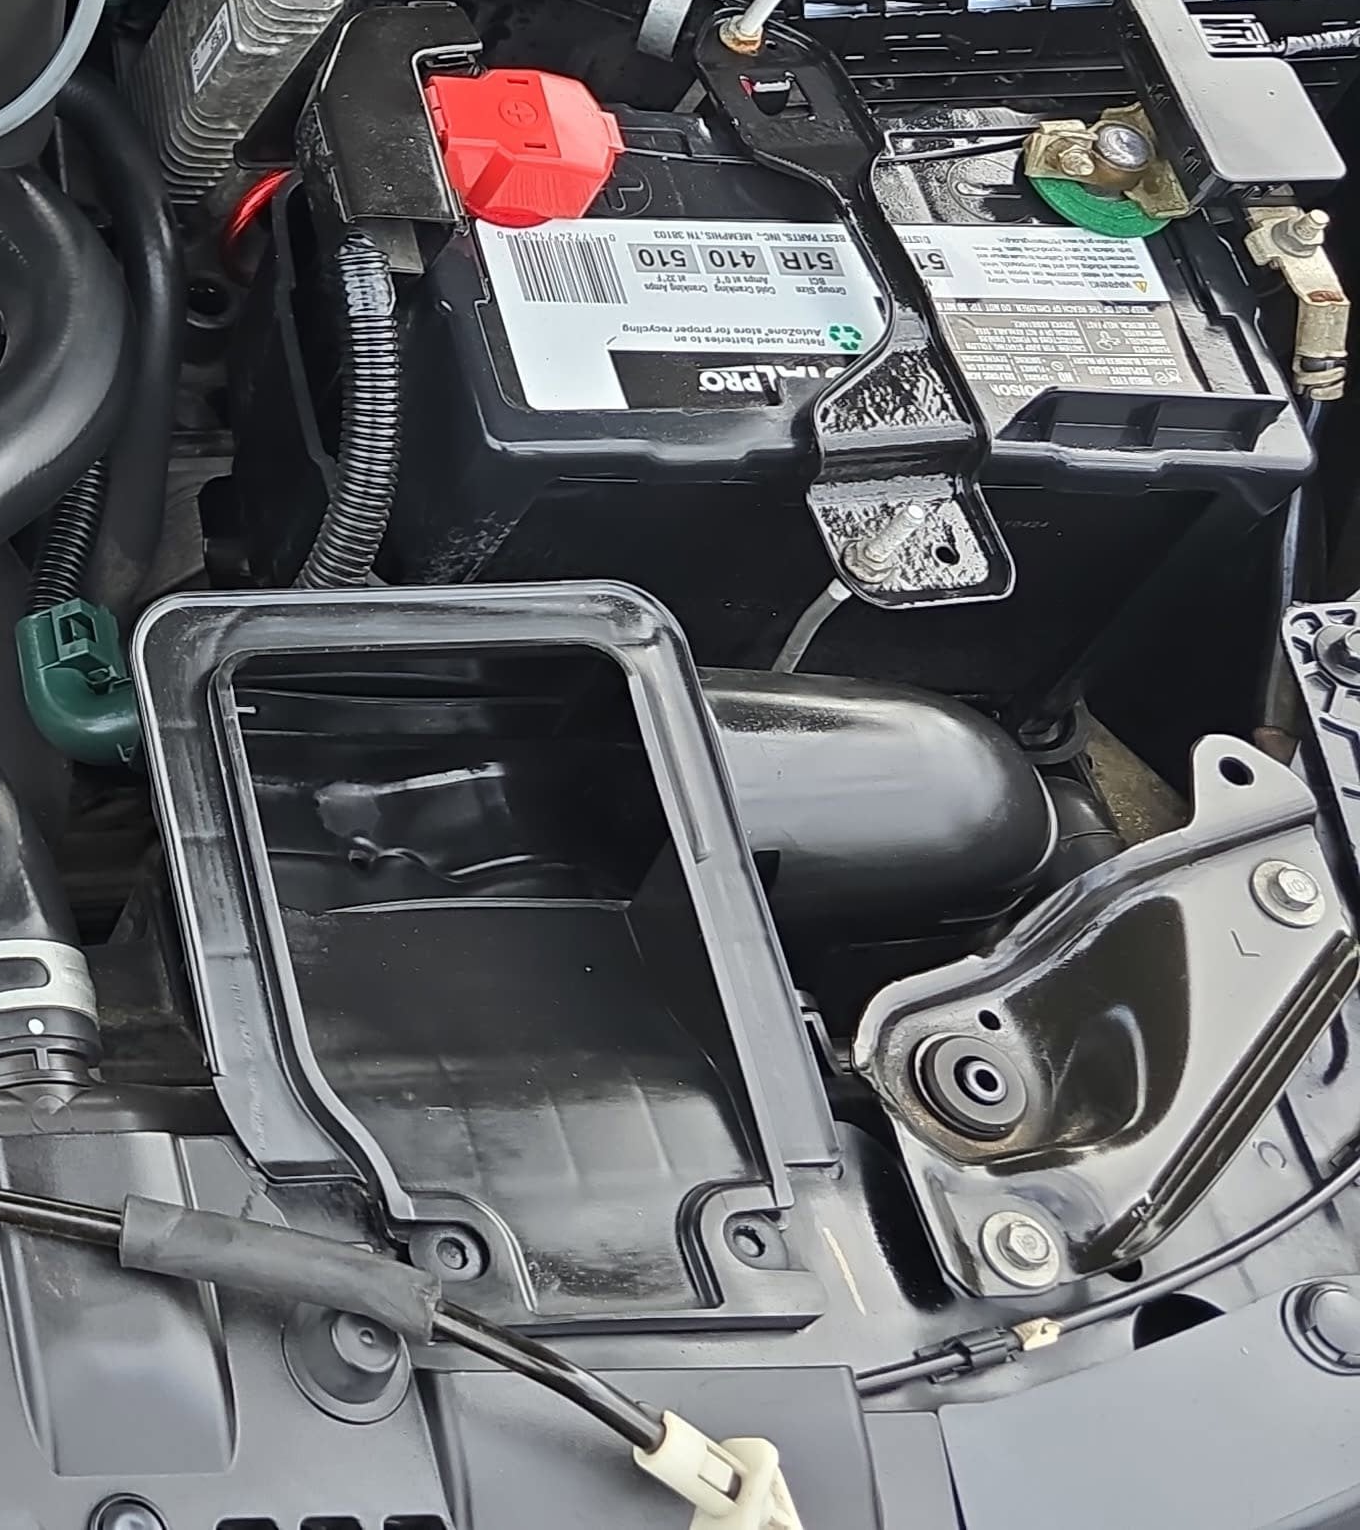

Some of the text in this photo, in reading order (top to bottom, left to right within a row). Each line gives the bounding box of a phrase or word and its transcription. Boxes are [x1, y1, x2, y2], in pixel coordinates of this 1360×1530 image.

[654, 231, 684, 239] 38103
[686, 231, 699, 239] TN
[819, 233, 846, 243] BEST
[638, 249, 686, 267] 510
[709, 250, 755, 268] 410
[779, 252, 834, 270] 51R
[744, 275, 768, 283] Amps
[809, 277, 826, 285] BCI
[644, 282, 708, 293] Cranking Amps
[714, 283, 776, 294] Cold Cranking
[795, 285, 846, 294] Group Size
[623, 324, 672, 334] recycling
[675, 325, 712, 334] proper
[715, 327, 730, 335] for
[734, 327, 761, 335] store
[705, 336, 753, 345] batteries
[757, 336, 783, 345] used
[787, 337, 825, 346] Return
[1057, 372, 1073, 382] NO
